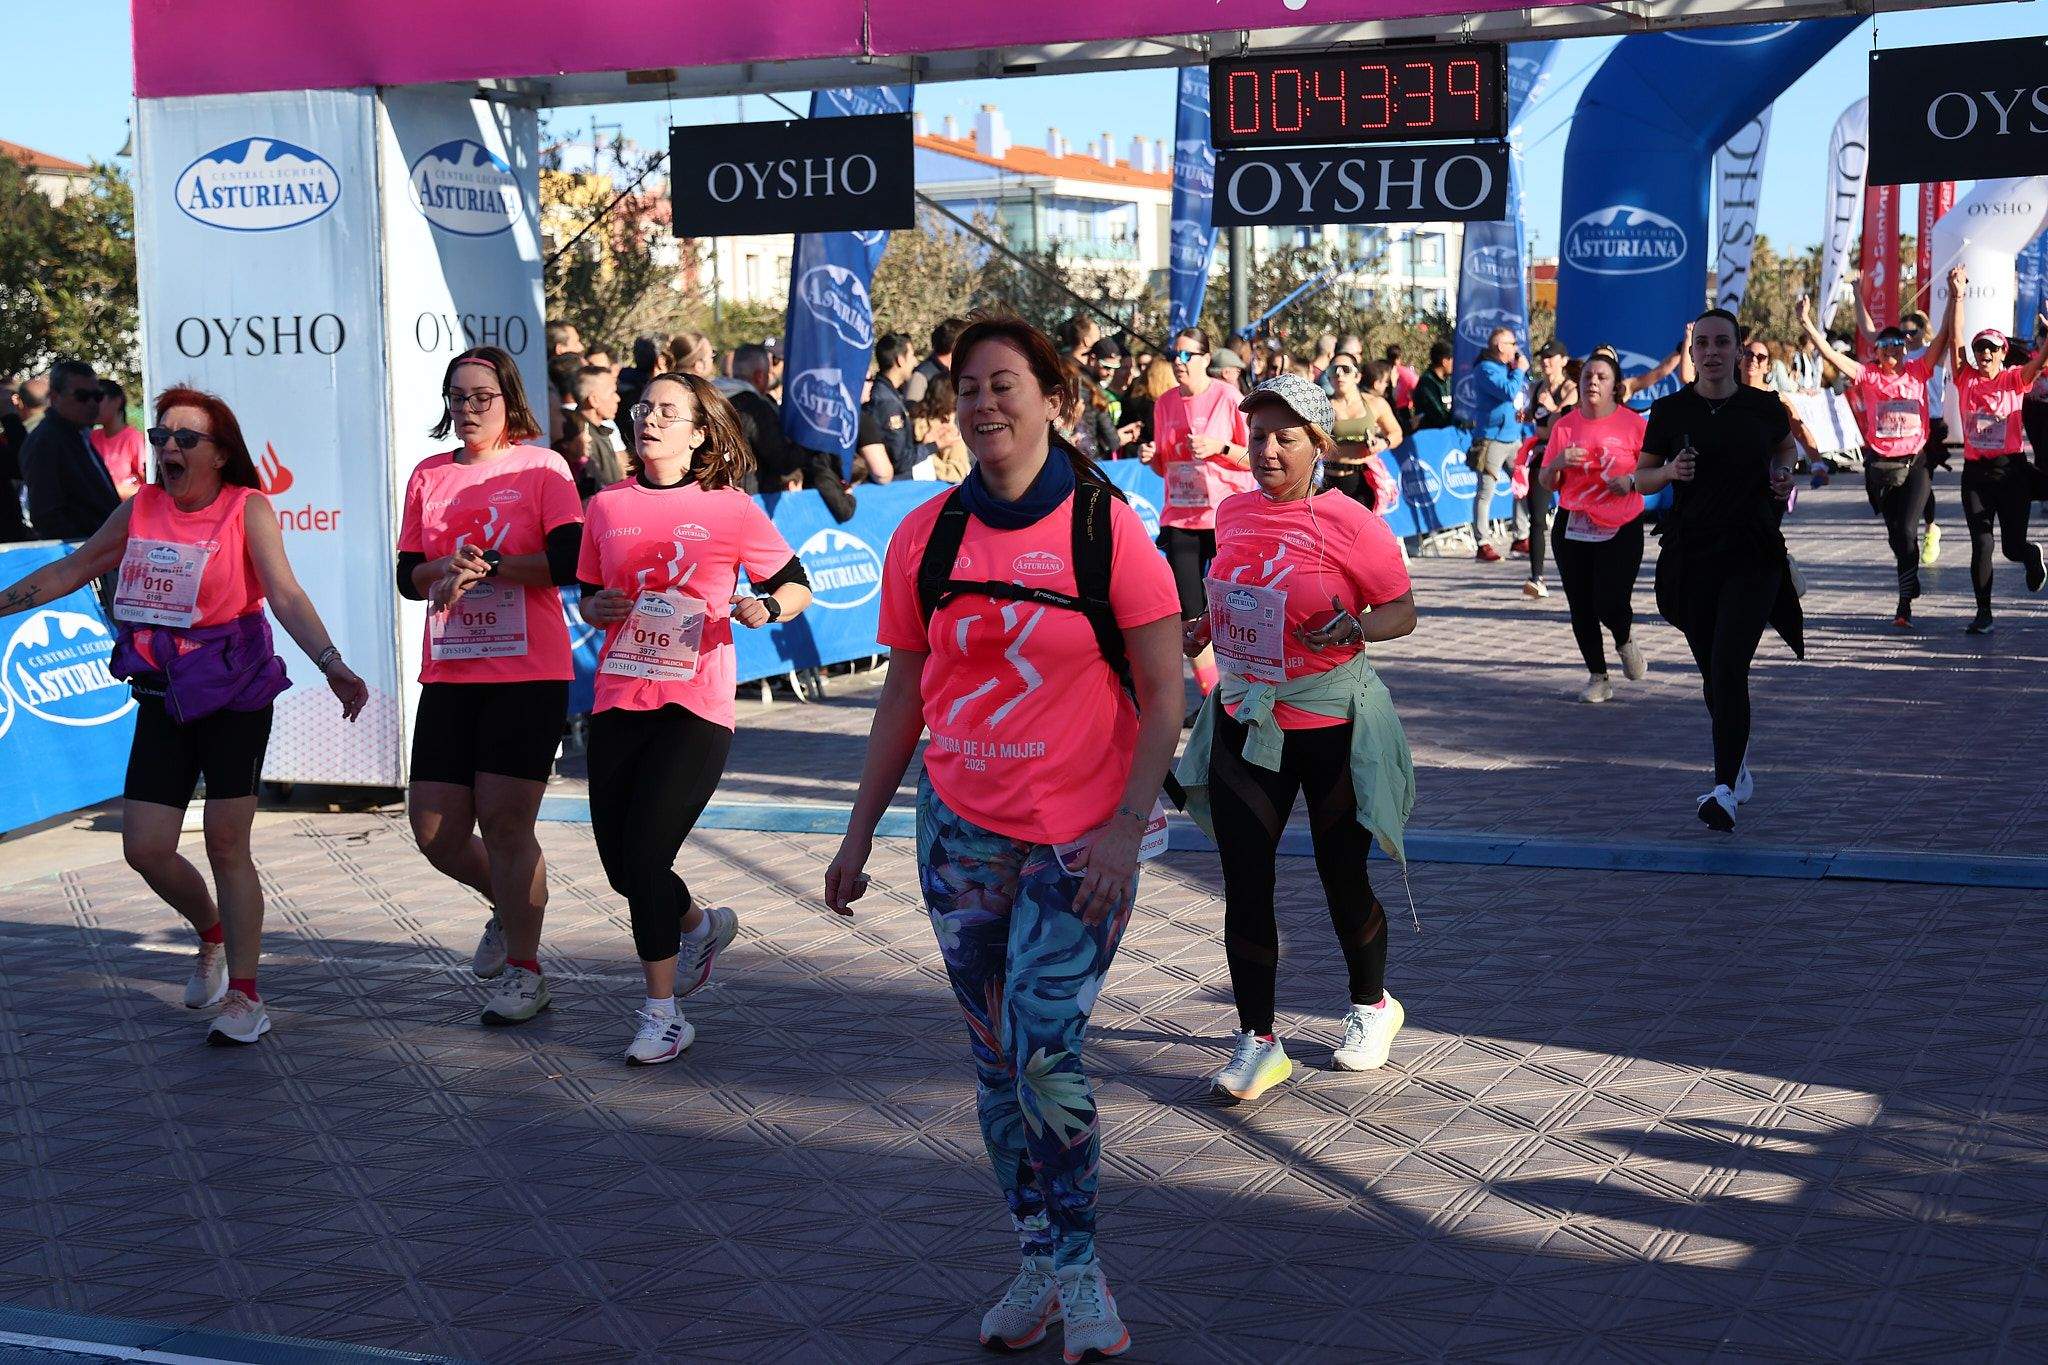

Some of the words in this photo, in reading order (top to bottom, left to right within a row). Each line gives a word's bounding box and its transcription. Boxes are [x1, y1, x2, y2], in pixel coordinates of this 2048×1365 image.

[707, 154, 878, 203] OYSHO
[1227, 155, 1493, 216] OYSHO
[188, 175, 330, 210] ASTURIANA
[420, 170, 517, 216] ASTURIANA
[1968, 201, 2032, 217] OYSHO
[1569, 233, 1679, 258] ASTURIANA
[175, 313, 347, 359] OYSHO
[415, 311, 529, 356] OYSHO
[278, 504, 342, 531] nder
[605, 526, 642, 539] OYSHO
[1016, 560, 1061, 572] ASTURIANA
[143, 577, 174, 593] 016
[462, 612, 498, 626] 016
[634, 629, 671, 648] 016
[1229, 624, 1258, 644] 016
[608, 661, 637, 672] OYSHO
[654, 669, 684, 679] Santander
[963, 740, 978, 757] DE
[982, 742, 997, 758] LA
[1000, 741, 1046, 759] MUJER
[964, 758, 986, 771] 2025
